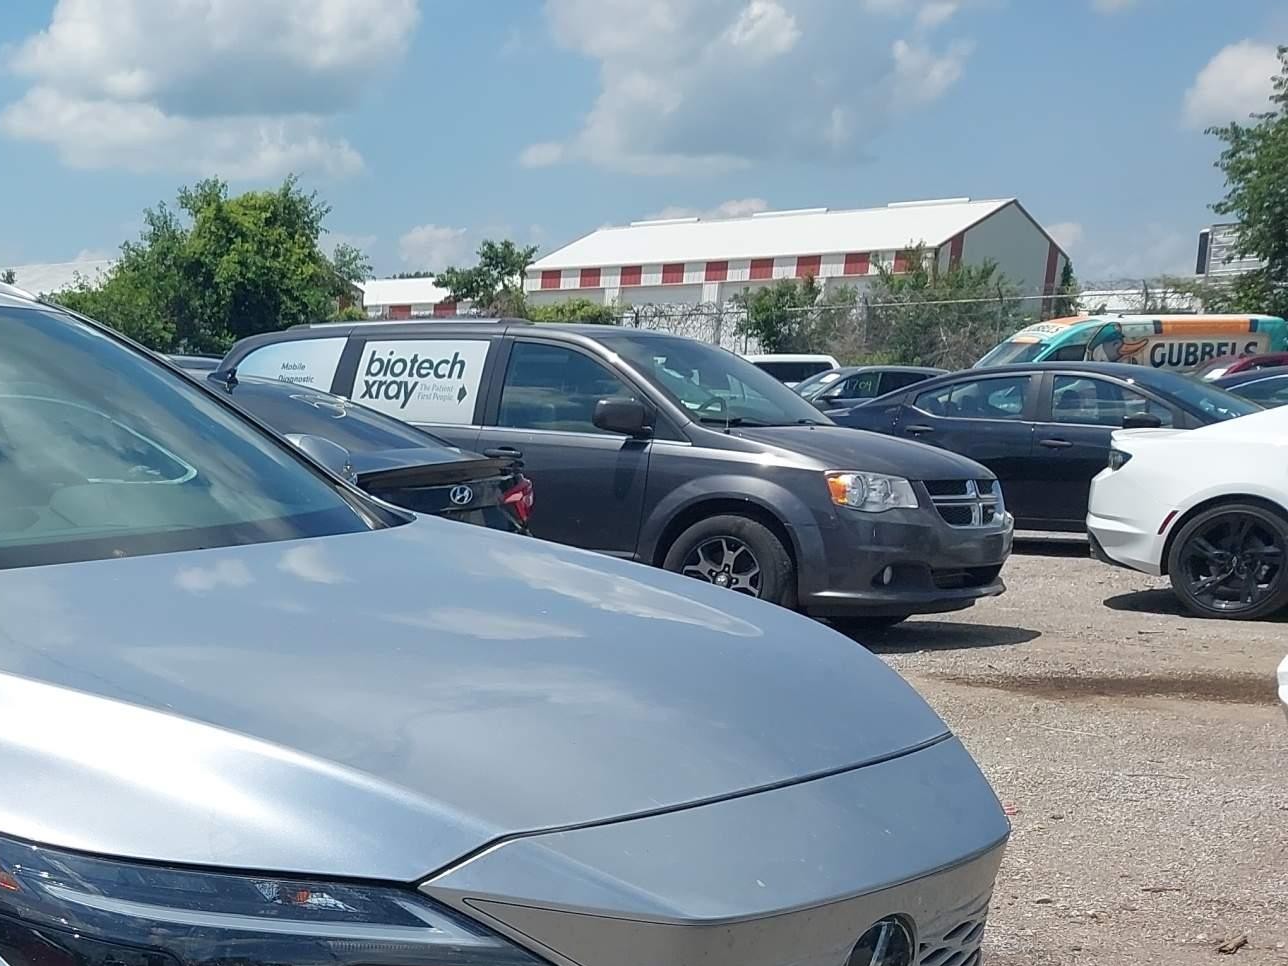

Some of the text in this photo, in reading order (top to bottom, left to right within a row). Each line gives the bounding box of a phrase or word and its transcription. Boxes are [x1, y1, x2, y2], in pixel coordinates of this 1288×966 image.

[281, 362, 305, 370] Mobile
[365, 350, 466, 379] biotech
[360, 379, 419, 409] xray
